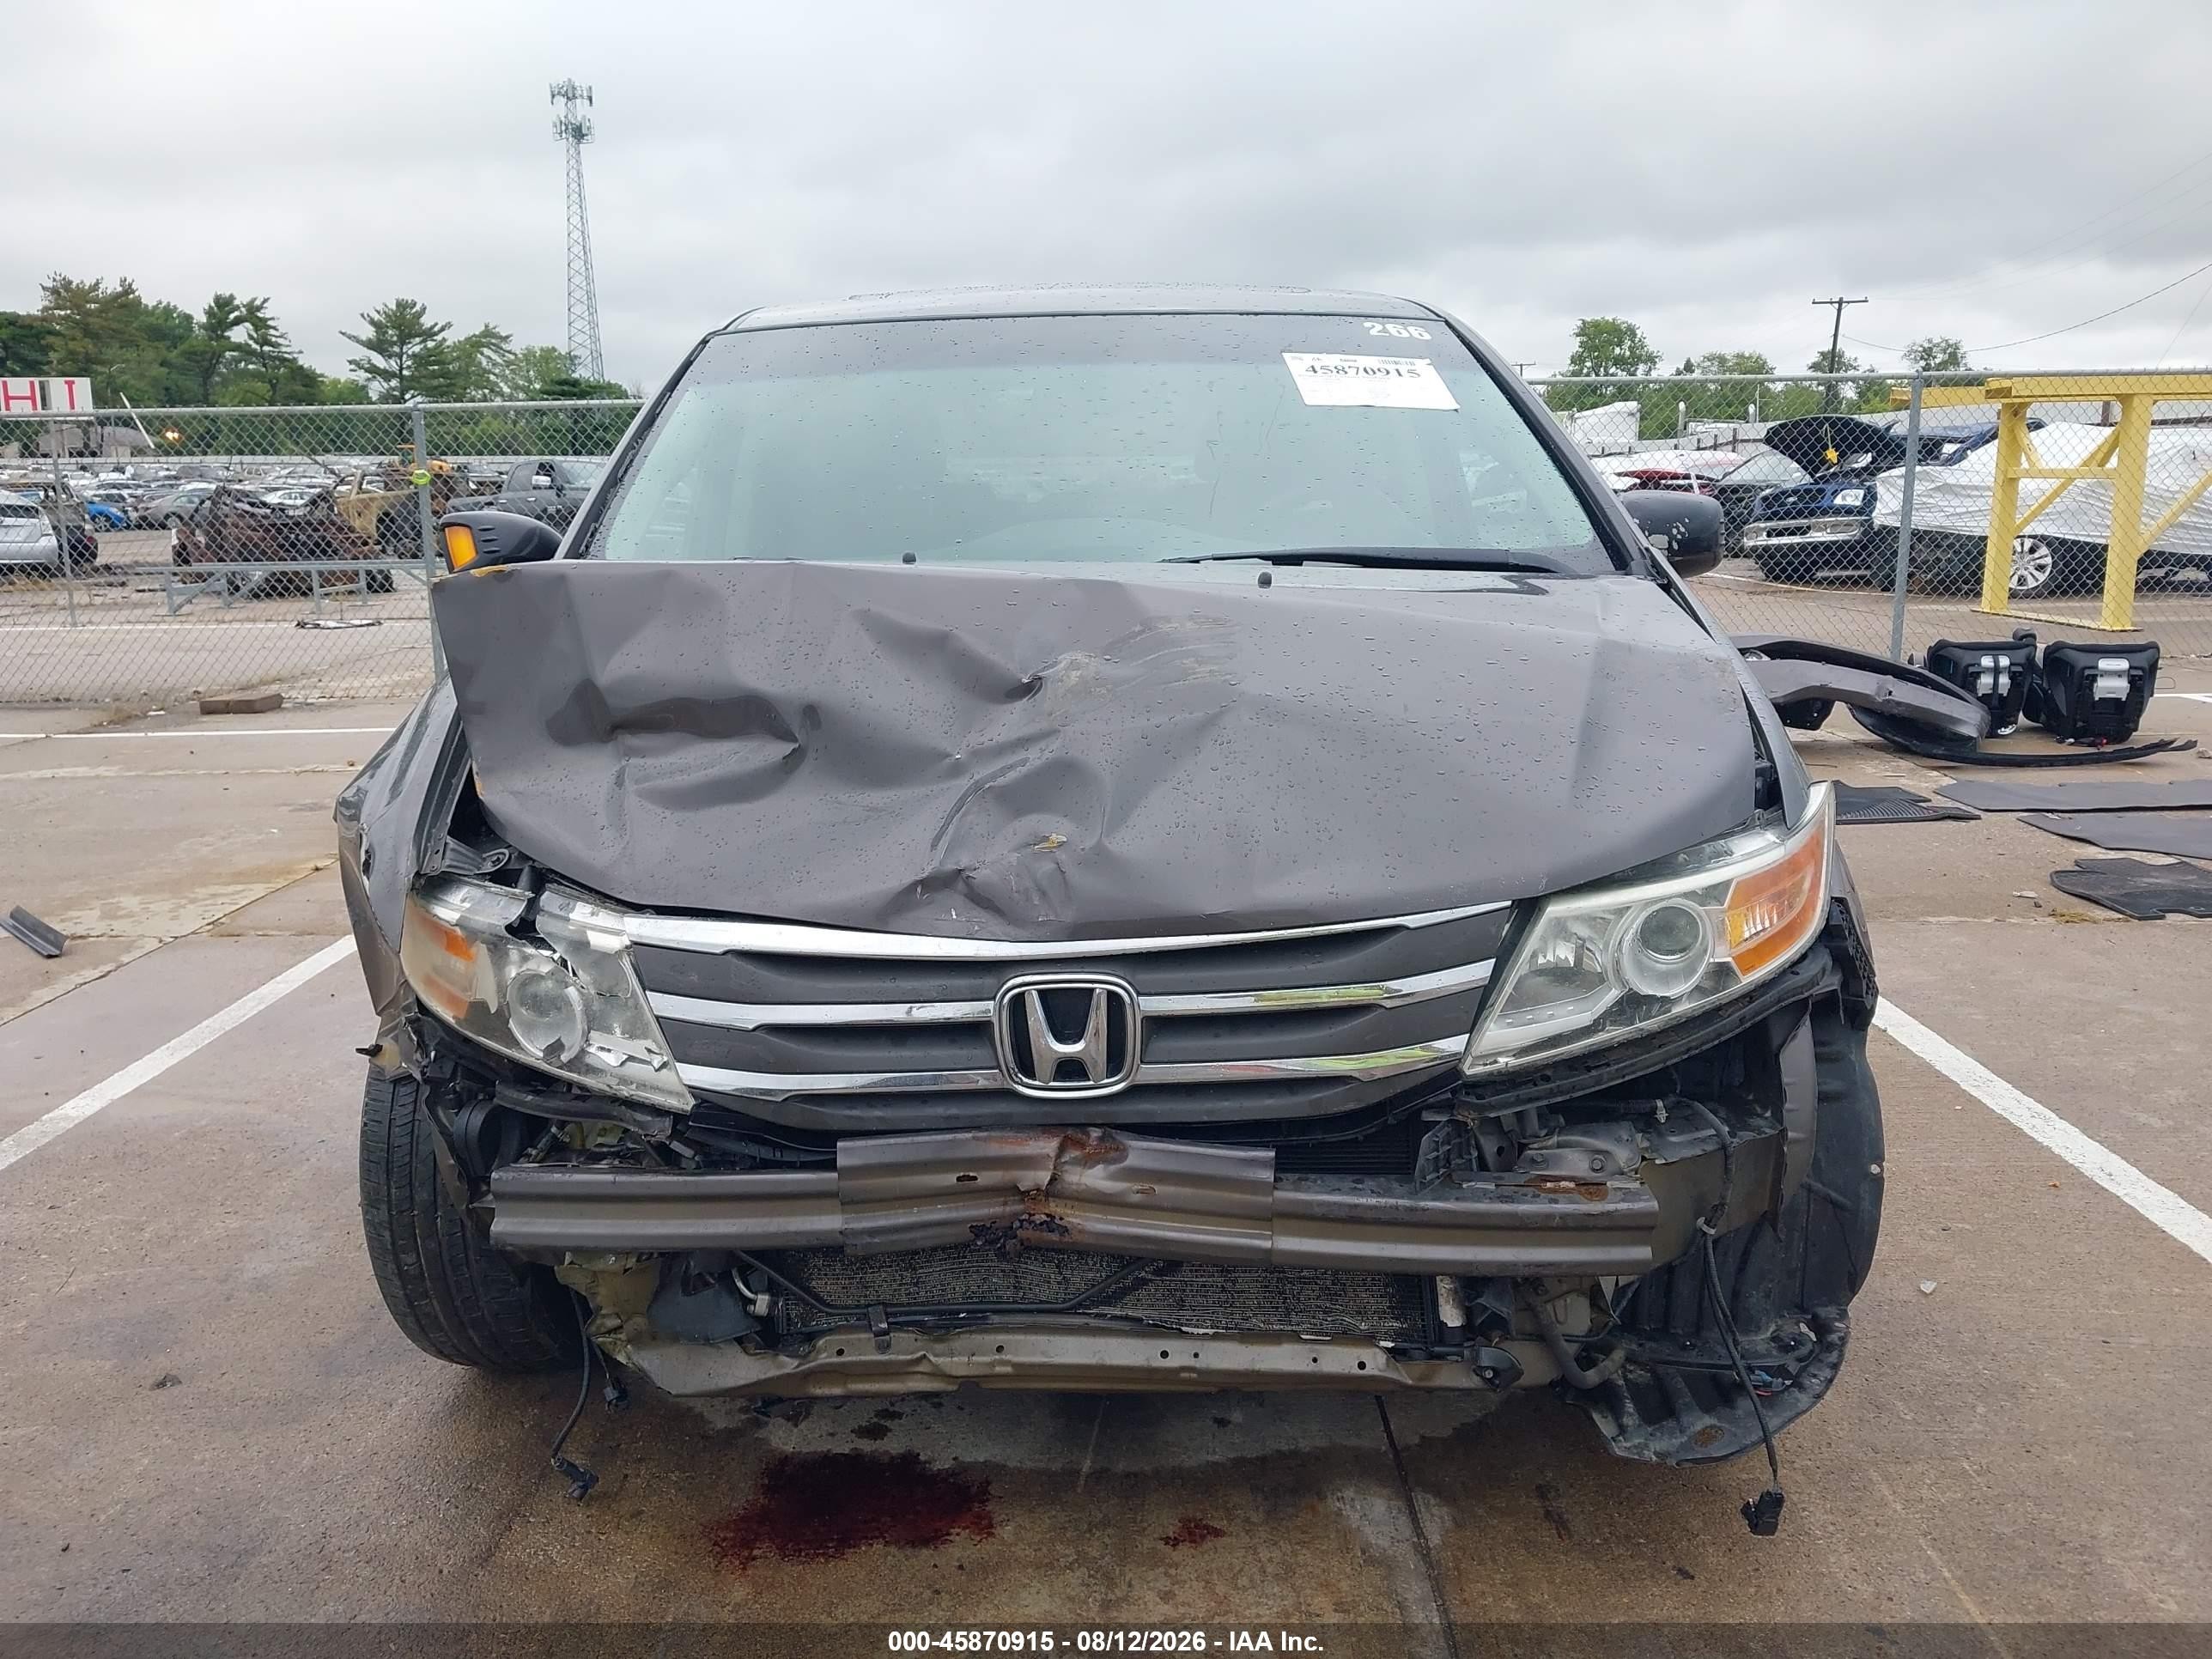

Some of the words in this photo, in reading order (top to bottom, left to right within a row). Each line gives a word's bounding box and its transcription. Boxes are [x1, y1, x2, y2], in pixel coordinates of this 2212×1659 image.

[1362, 321, 1432, 340] 266
[1305, 364, 1421, 379] 45870915
[2, 380, 38, 410] H
